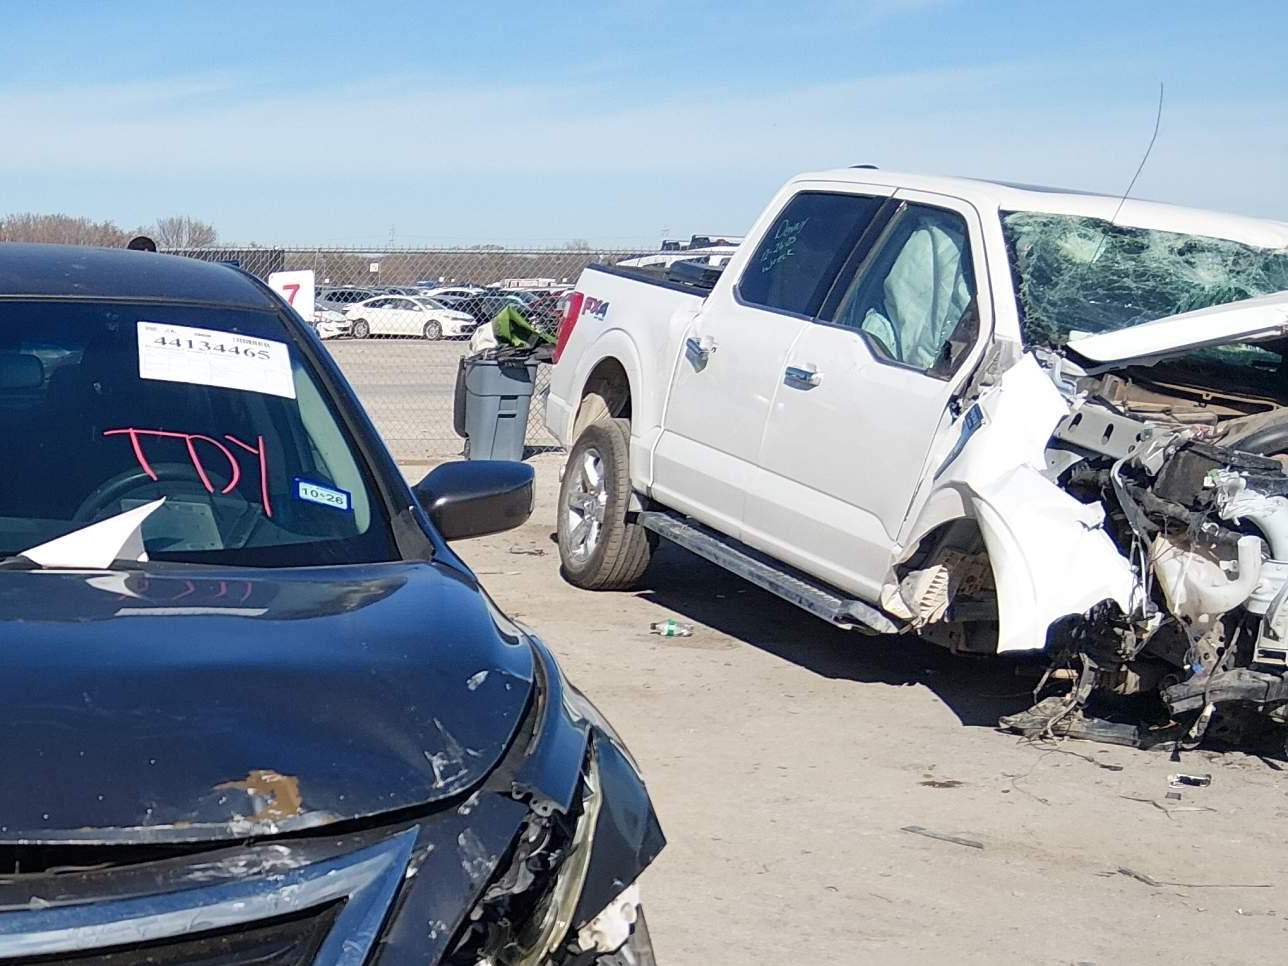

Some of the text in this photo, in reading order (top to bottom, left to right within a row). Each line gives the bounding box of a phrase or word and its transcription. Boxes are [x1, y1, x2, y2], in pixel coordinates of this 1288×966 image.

[282, 283, 301, 306] 7
[154, 335, 272, 361] 44134465
[104, 427, 272, 518] TDY
